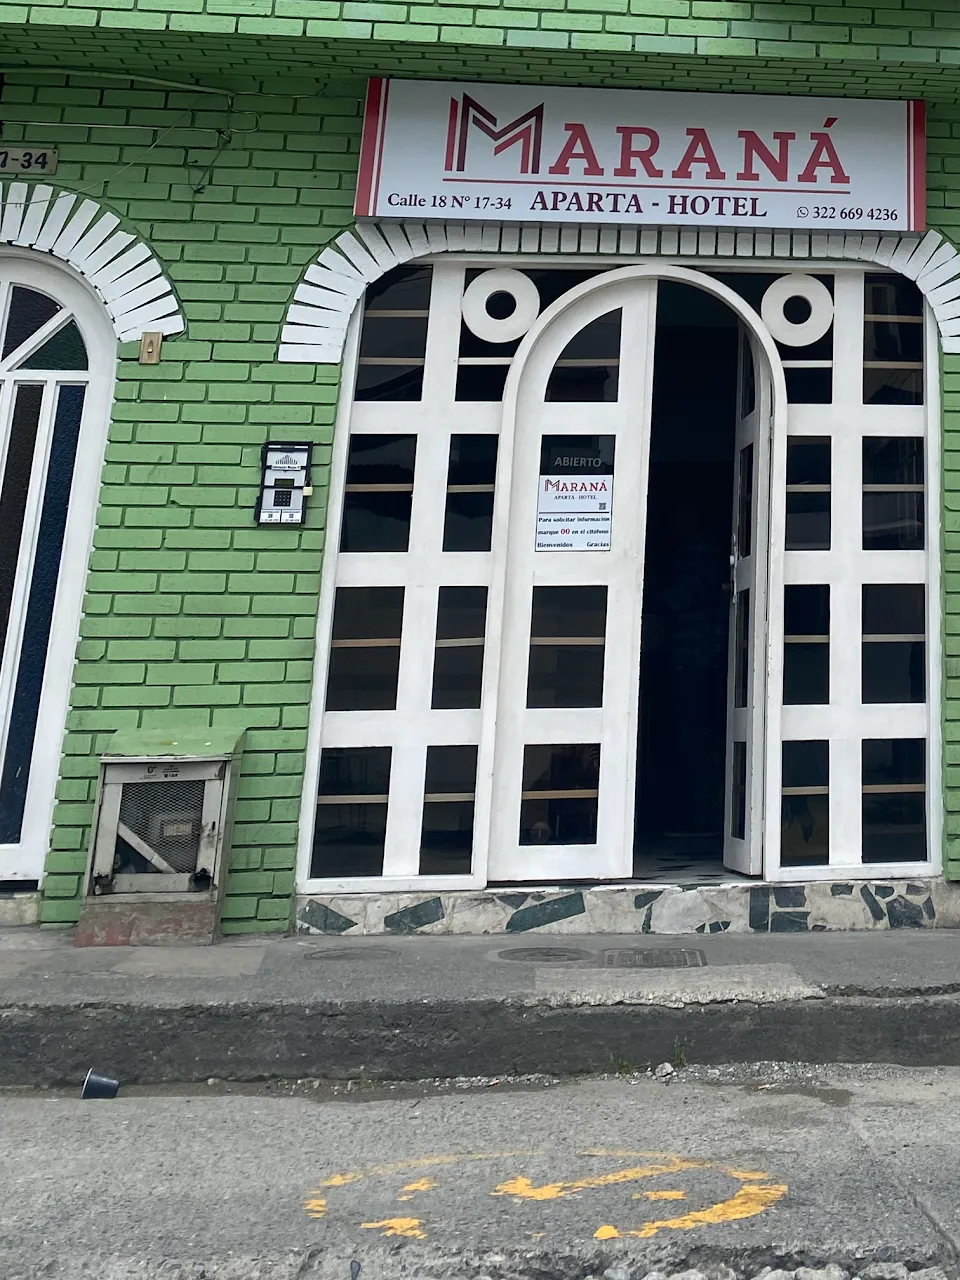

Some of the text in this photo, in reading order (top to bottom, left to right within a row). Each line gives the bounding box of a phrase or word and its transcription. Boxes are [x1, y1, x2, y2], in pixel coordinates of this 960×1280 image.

[444, 92, 850, 184] MARANÁ
[388, 193, 426, 207] Calle
[431, 195, 447, 208] 18
[474, 196, 512, 210] 17-34
[530, 191, 643, 213] APARTA
[667, 195, 767, 217] HOTEL
[813, 206, 898, 221] 322 669 4236
[554, 456, 602, 467] ABIERTO
[544, 479, 608, 492] MARANÁ
